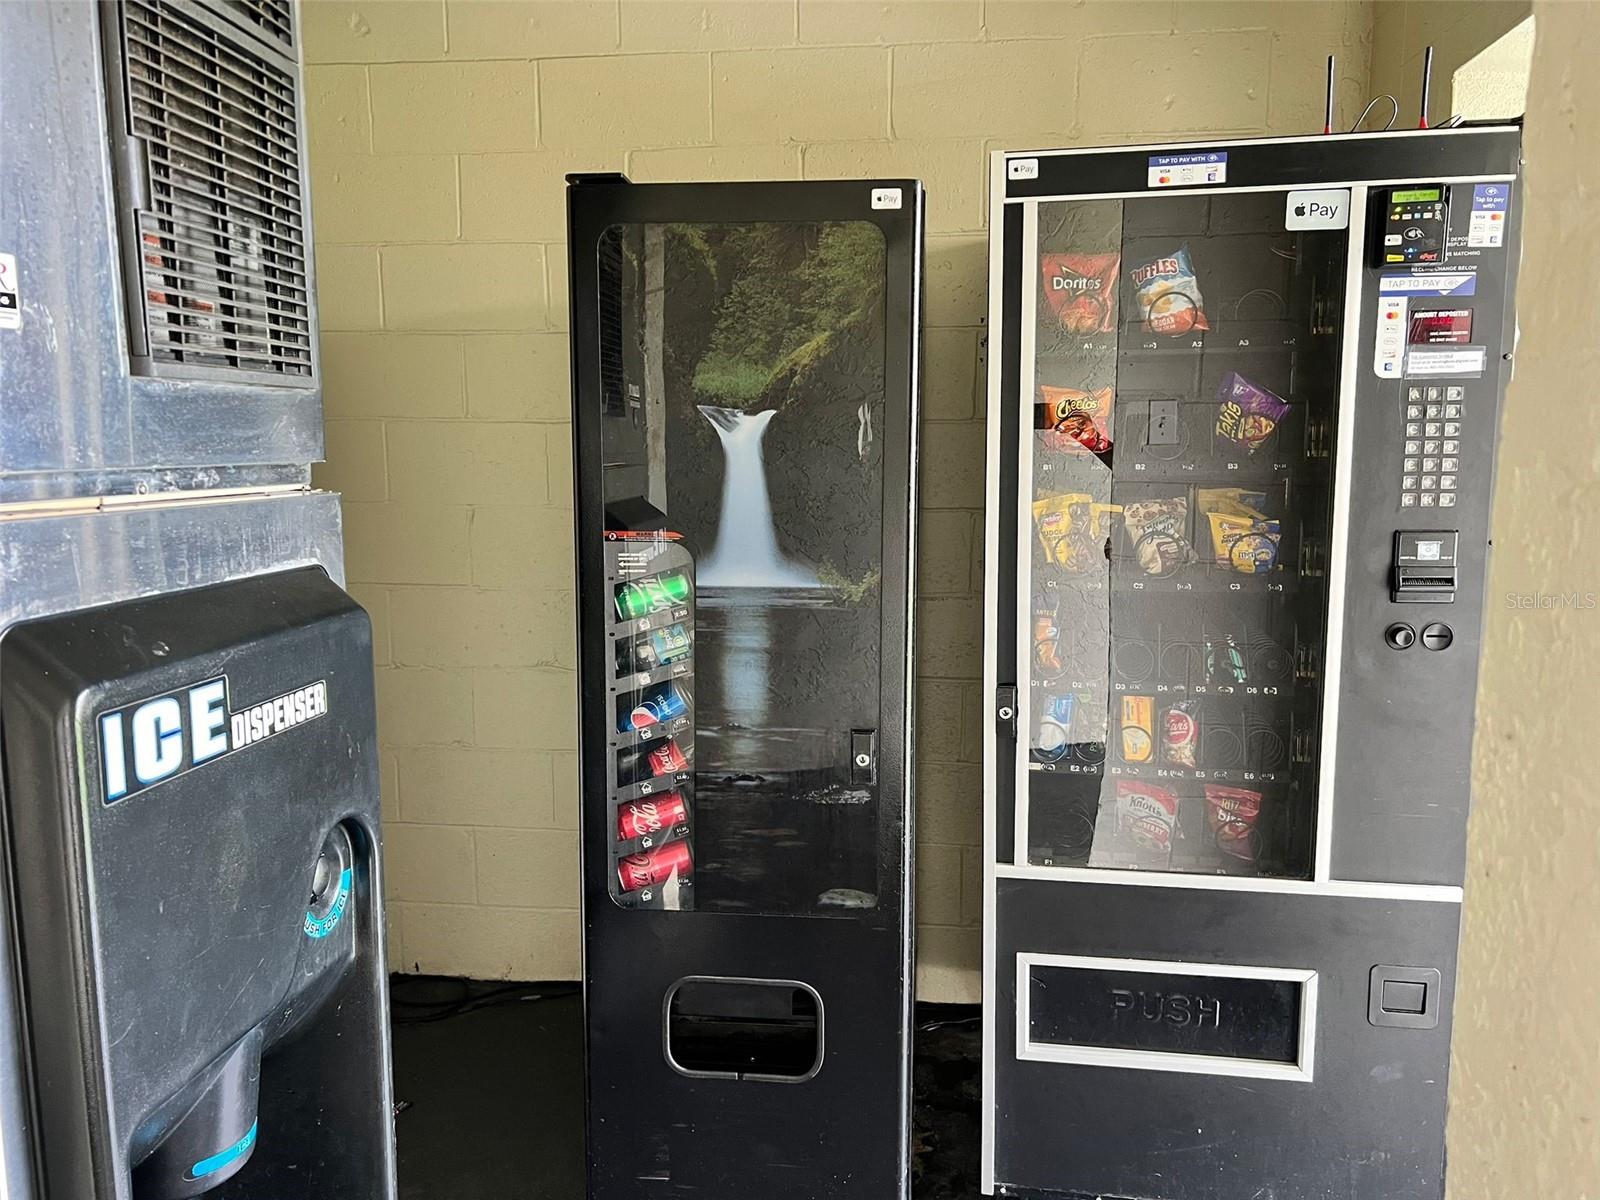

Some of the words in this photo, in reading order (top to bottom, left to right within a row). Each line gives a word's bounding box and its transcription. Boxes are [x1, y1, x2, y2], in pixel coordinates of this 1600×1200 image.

[1020, 165, 1034, 174] Pay
[884, 194, 898, 204] Pay
[1309, 202, 1339, 220] Pay
[1053, 277, 1101, 290] Doritos
[1388, 280, 1406, 288] TAP
[1422, 279, 1440, 287] PAY
[1056, 397, 1099, 419] Cheetos
[1215, 400, 1242, 439] Takis
[655, 694, 673, 716] pepsi
[101, 680, 228, 801] ICE
[230, 683, 327, 750] DISPENSER
[304, 919, 320, 934] USH
[322, 913, 338, 932] FOR
[337, 892, 347, 911] ICE
[1111, 988, 1220, 1030] PUSH
